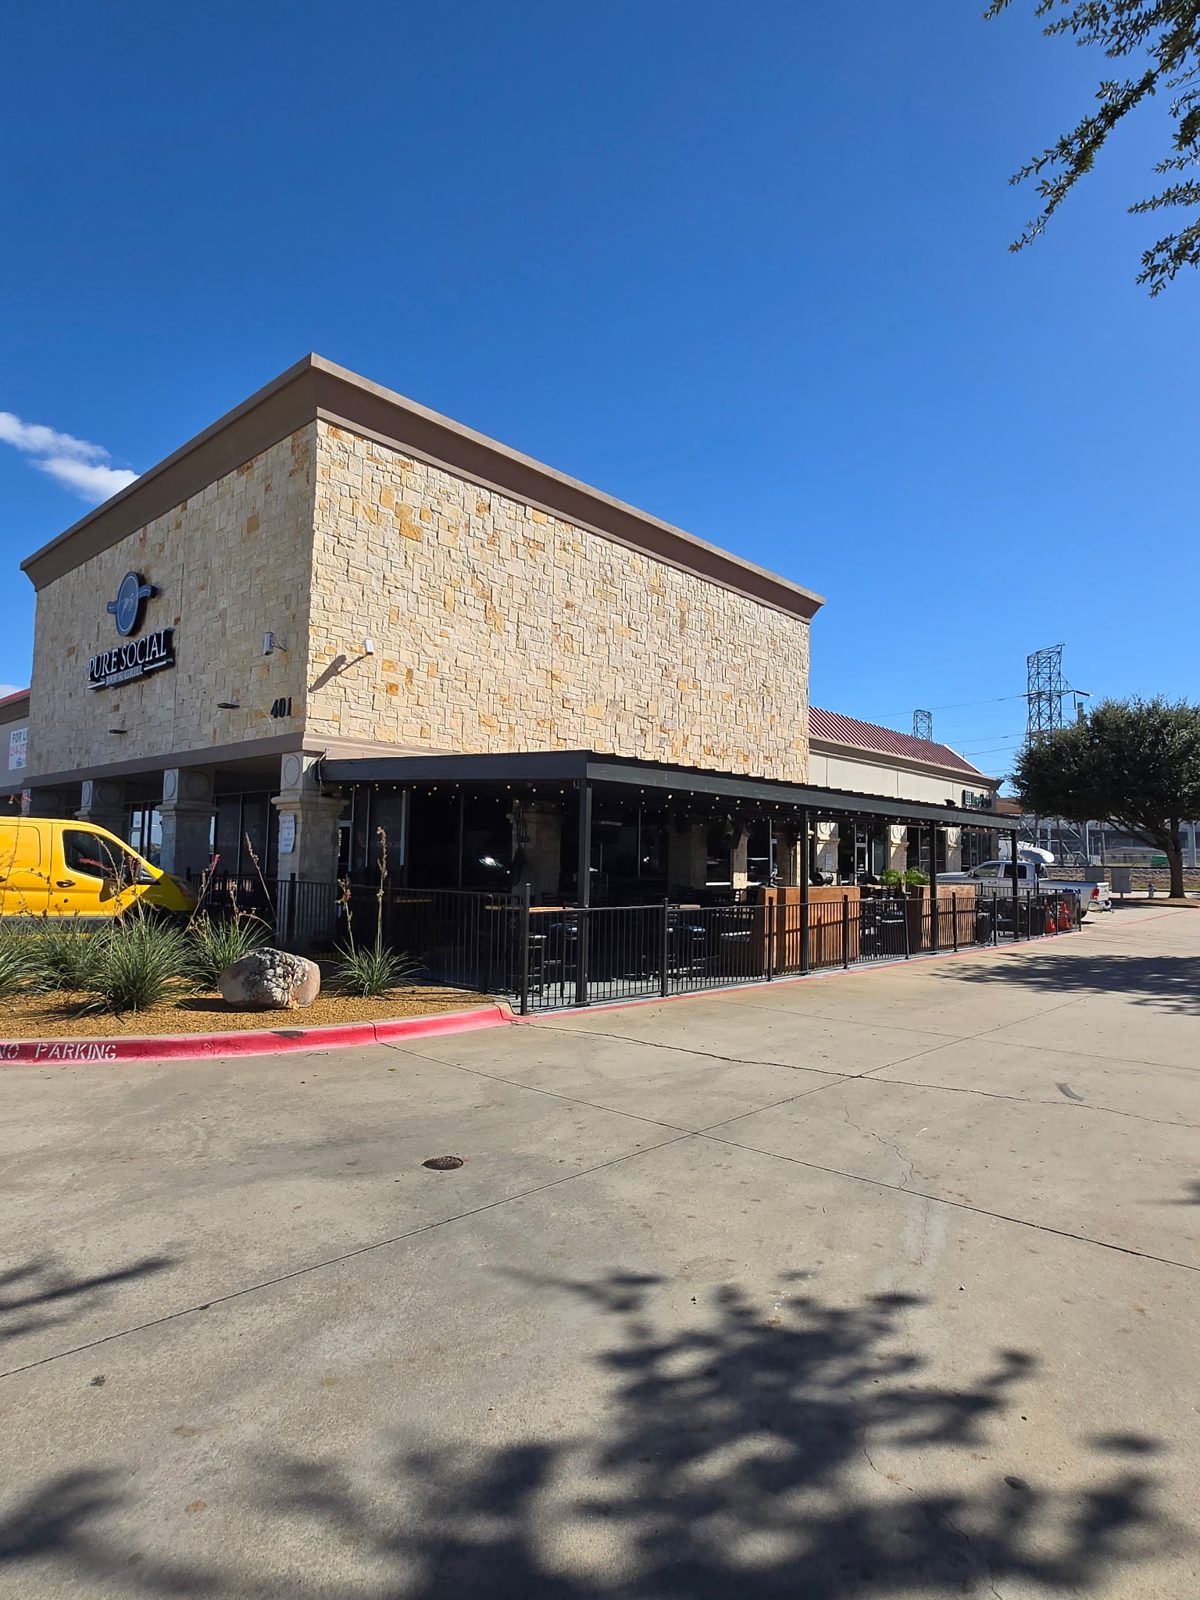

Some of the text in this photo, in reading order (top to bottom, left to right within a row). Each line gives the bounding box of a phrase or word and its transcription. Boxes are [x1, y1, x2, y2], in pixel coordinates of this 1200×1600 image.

[88, 648, 119, 680] PURE
[120, 630, 167, 670] SOCIAL
[270, 696, 292, 718] 401
[35, 1043, 117, 1060] PARKING
